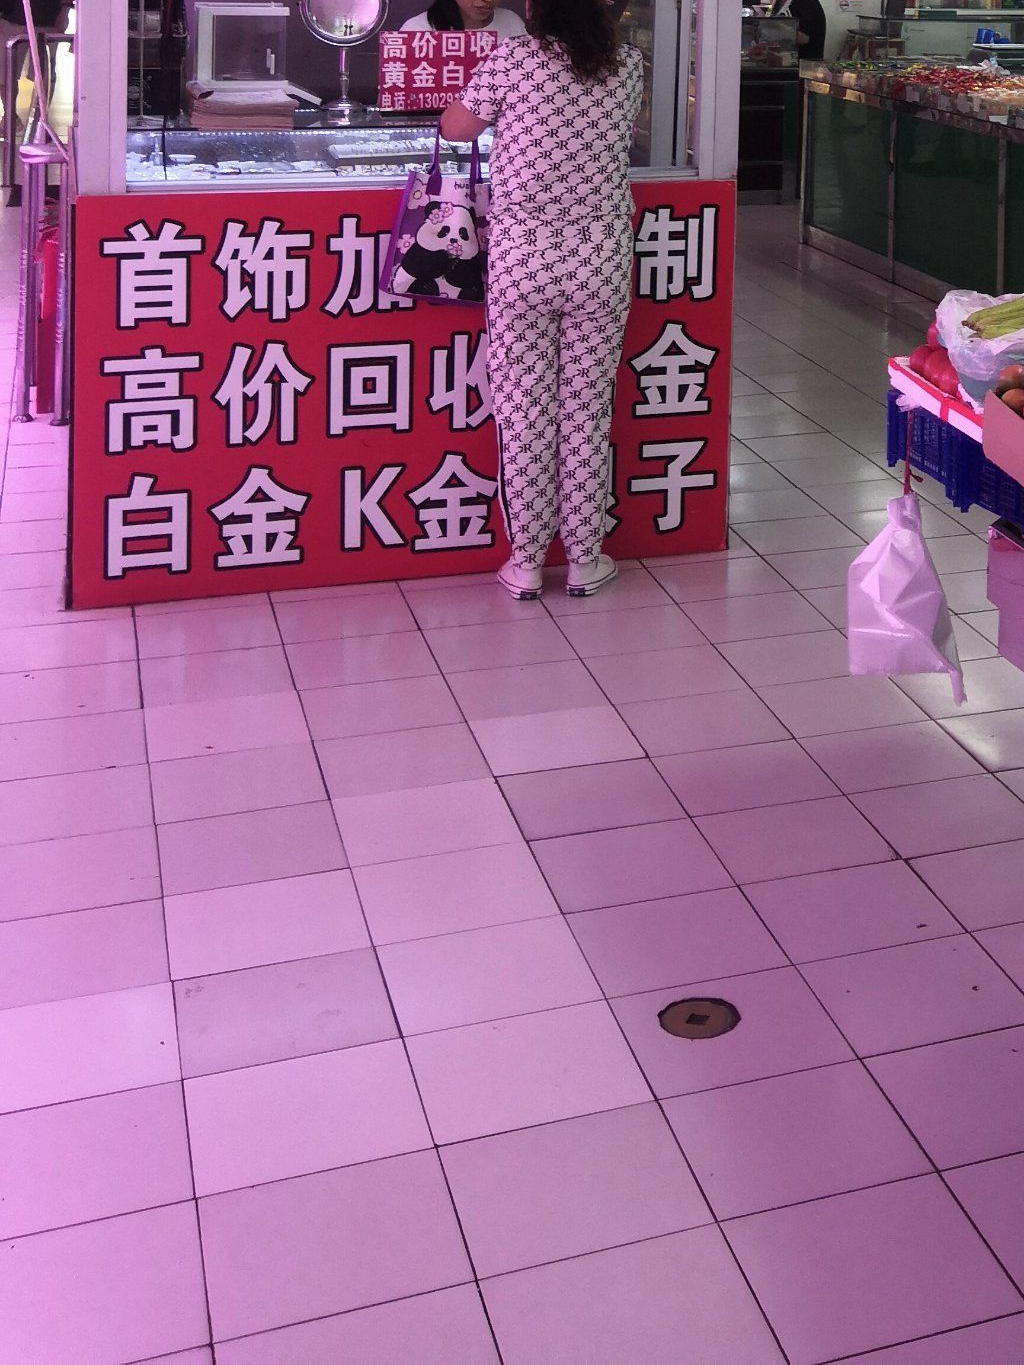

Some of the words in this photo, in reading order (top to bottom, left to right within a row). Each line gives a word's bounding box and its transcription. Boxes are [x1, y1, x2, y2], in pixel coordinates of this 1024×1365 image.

[380, 31, 497, 59] 高价回收
[101, 204, 717, 330] 首饰加制
[101, 321, 717, 455] 高价回收金
[102, 436, 716, 580] 白金K金子
